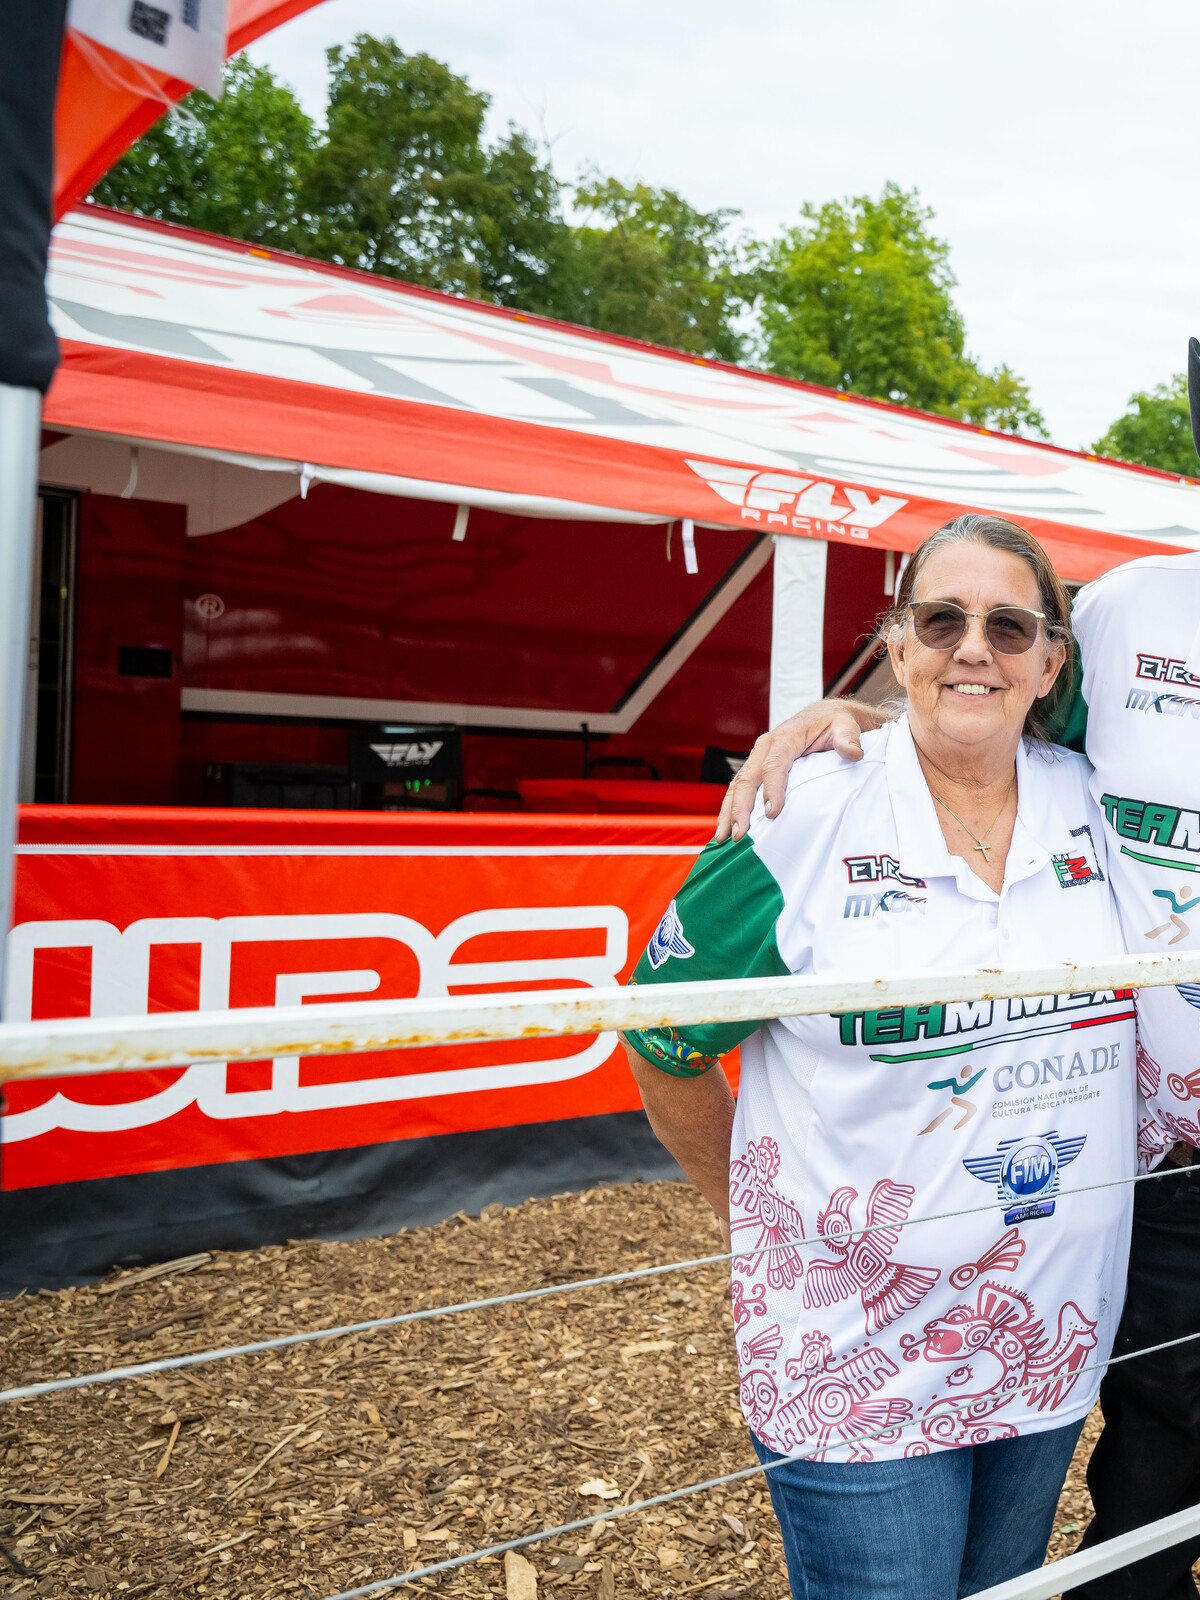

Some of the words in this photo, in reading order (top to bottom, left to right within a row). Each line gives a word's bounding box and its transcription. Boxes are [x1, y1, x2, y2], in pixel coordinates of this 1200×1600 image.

[740, 507, 869, 539] RACING
[992, 1041, 1121, 1093] CONADE
[991, 1106, 1032, 1119] CULTURA
[1068, 1090, 1101, 1104] DEPORTE
[1037, 1088, 1077, 1102] NACIONAL
[1079, 1084, 1089, 1093] DE
[1010, 1155, 1050, 1185] FIM
